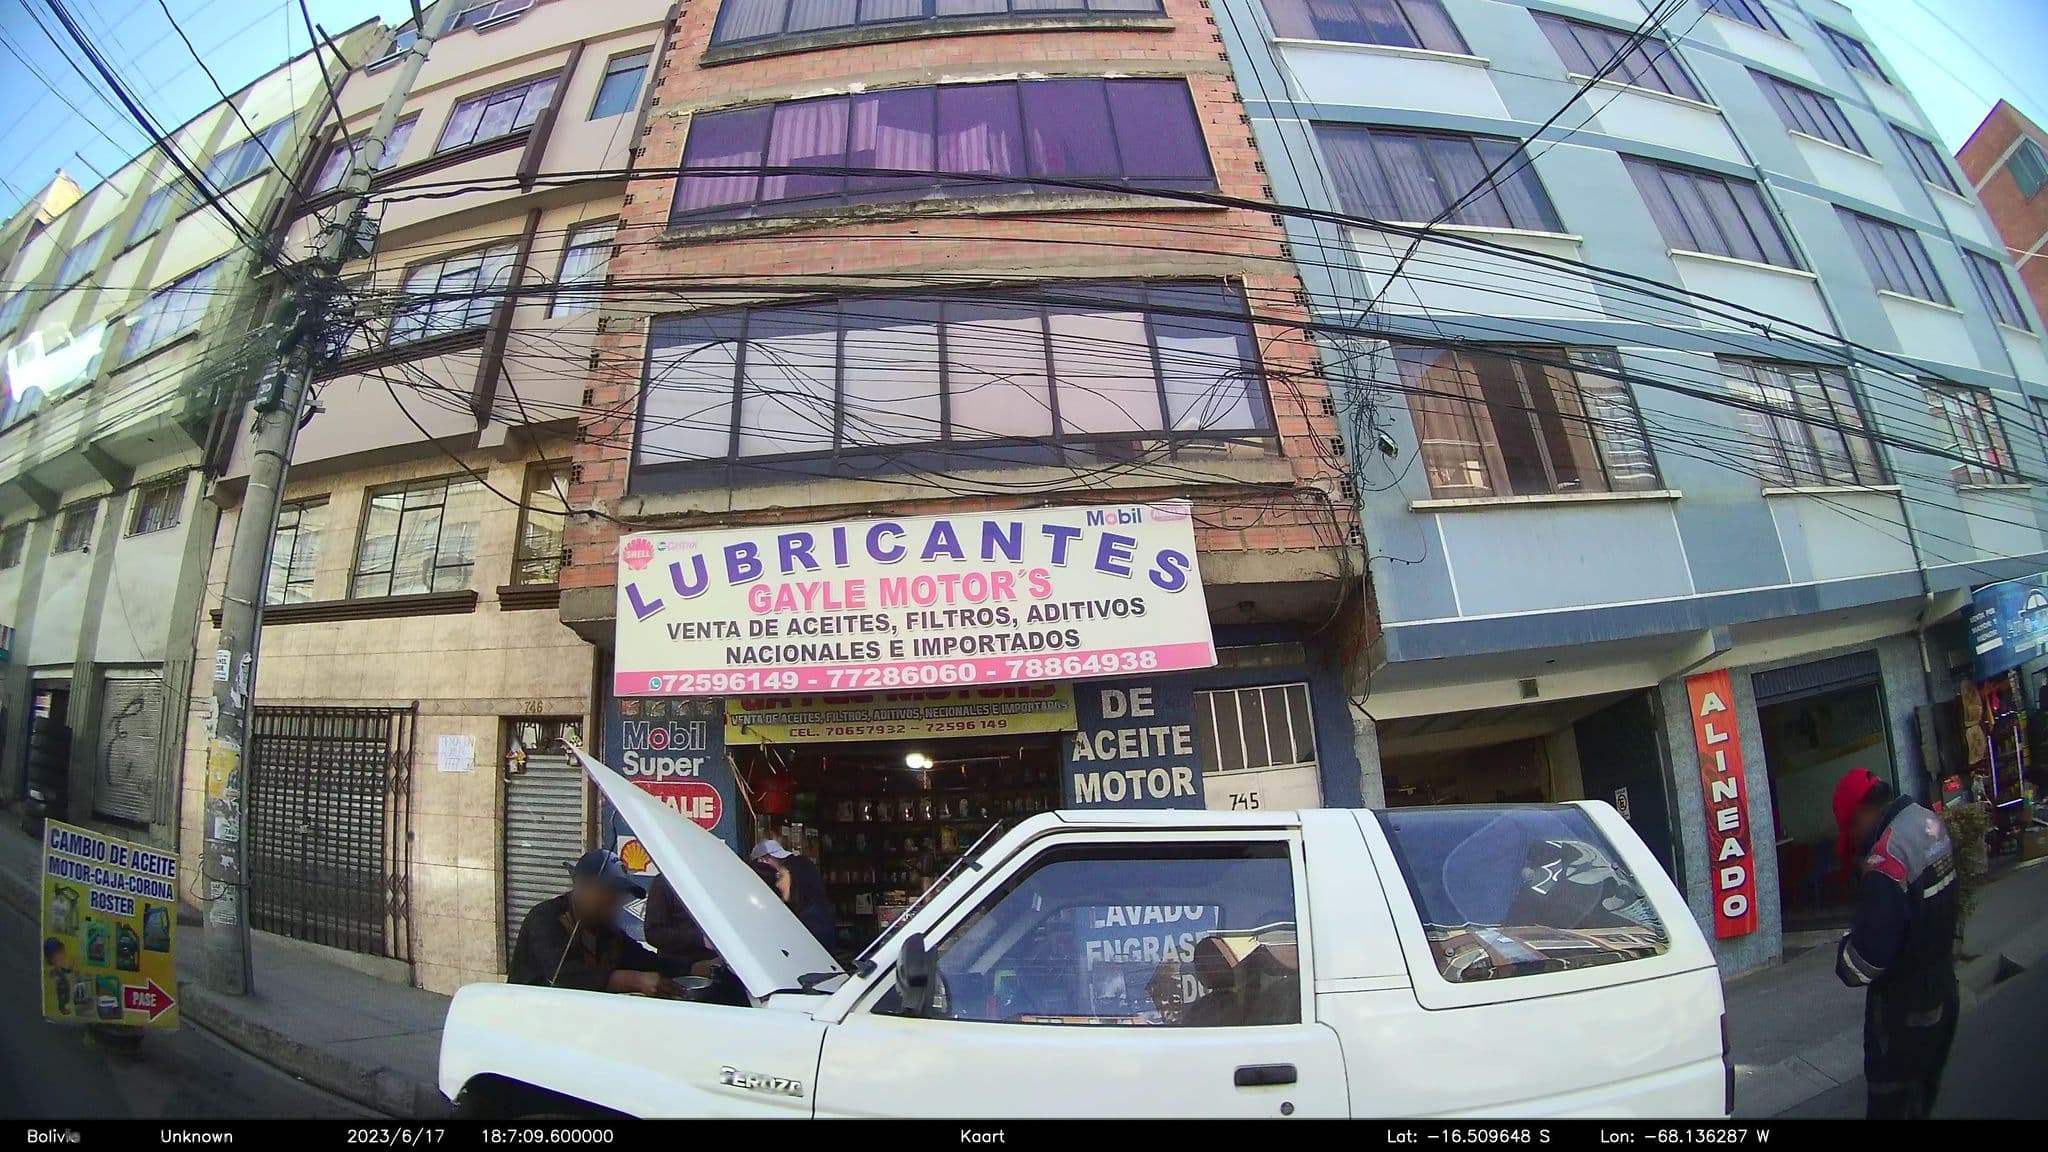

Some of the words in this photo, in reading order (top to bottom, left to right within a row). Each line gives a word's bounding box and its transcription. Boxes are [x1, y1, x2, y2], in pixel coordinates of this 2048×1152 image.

[1087, 508, 1142, 526] Mobil
[625, 521, 1190, 620] LUBRICANTES
[627, 550, 650, 559] SHELL
[748, 578, 866, 614] GAYLE
[667, 621, 741, 640] VENTA
[750, 619, 778, 637] DE
[787, 613, 897, 636] ACEITES,
[907, 607, 1018, 630] FILTROS,
[1027, 597, 1146, 623] ADITIVOS
[727, 640, 881, 664] NACIONALES
[890, 640, 904, 657] E
[914, 629, 1080, 656] IMPORTADOS
[663, 671, 799, 692] 72596149
[827, 663, 977, 689] 77286060
[1006, 651, 1158, 678] 78864938
[524, 701, 544, 713] 746
[1101, 687, 1155, 719] DE
[622, 720, 707, 750] Mobil
[790, 728, 820, 737] CEL.
[826, 725, 906, 736] 70657932
[1072, 725, 1193, 762] ACEITE
[622, 751, 704, 781] Super
[1074, 766, 1197, 803] MOTOR
[1229, 792, 1259, 811] 745
[1700, 691, 1748, 917] ALINEADO
[50, 828, 106, 863] CAMBIO
[110, 845, 128, 867] DE
[131, 851, 176, 878] ACEITE
[91, 890, 135, 915] ROSTER
[132, 991, 157, 1007] PASE
